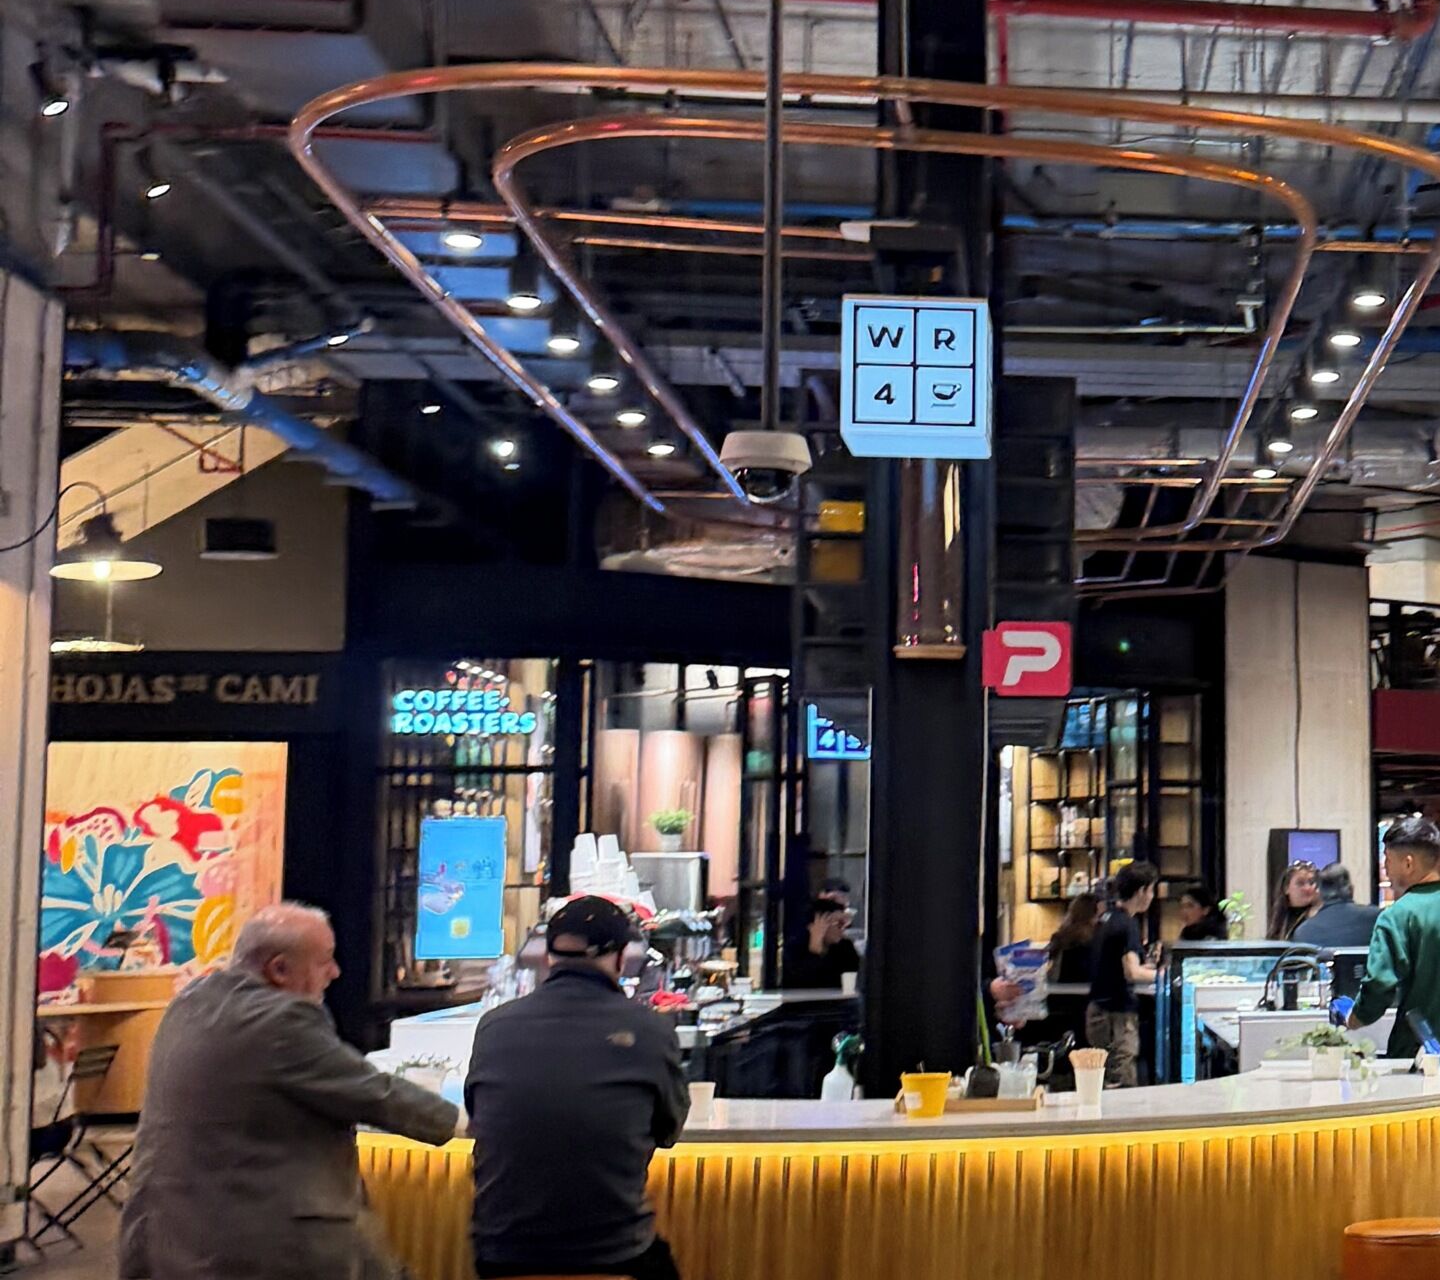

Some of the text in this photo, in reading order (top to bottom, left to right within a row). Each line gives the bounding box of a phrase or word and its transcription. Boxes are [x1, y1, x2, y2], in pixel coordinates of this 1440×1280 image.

[867, 324, 957, 351] W R
[874, 383, 896, 405] 4
[51, 675, 176, 704] HOJAS
[214, 675, 319, 704] CAMI
[391, 712, 537, 734] ROASTERS
